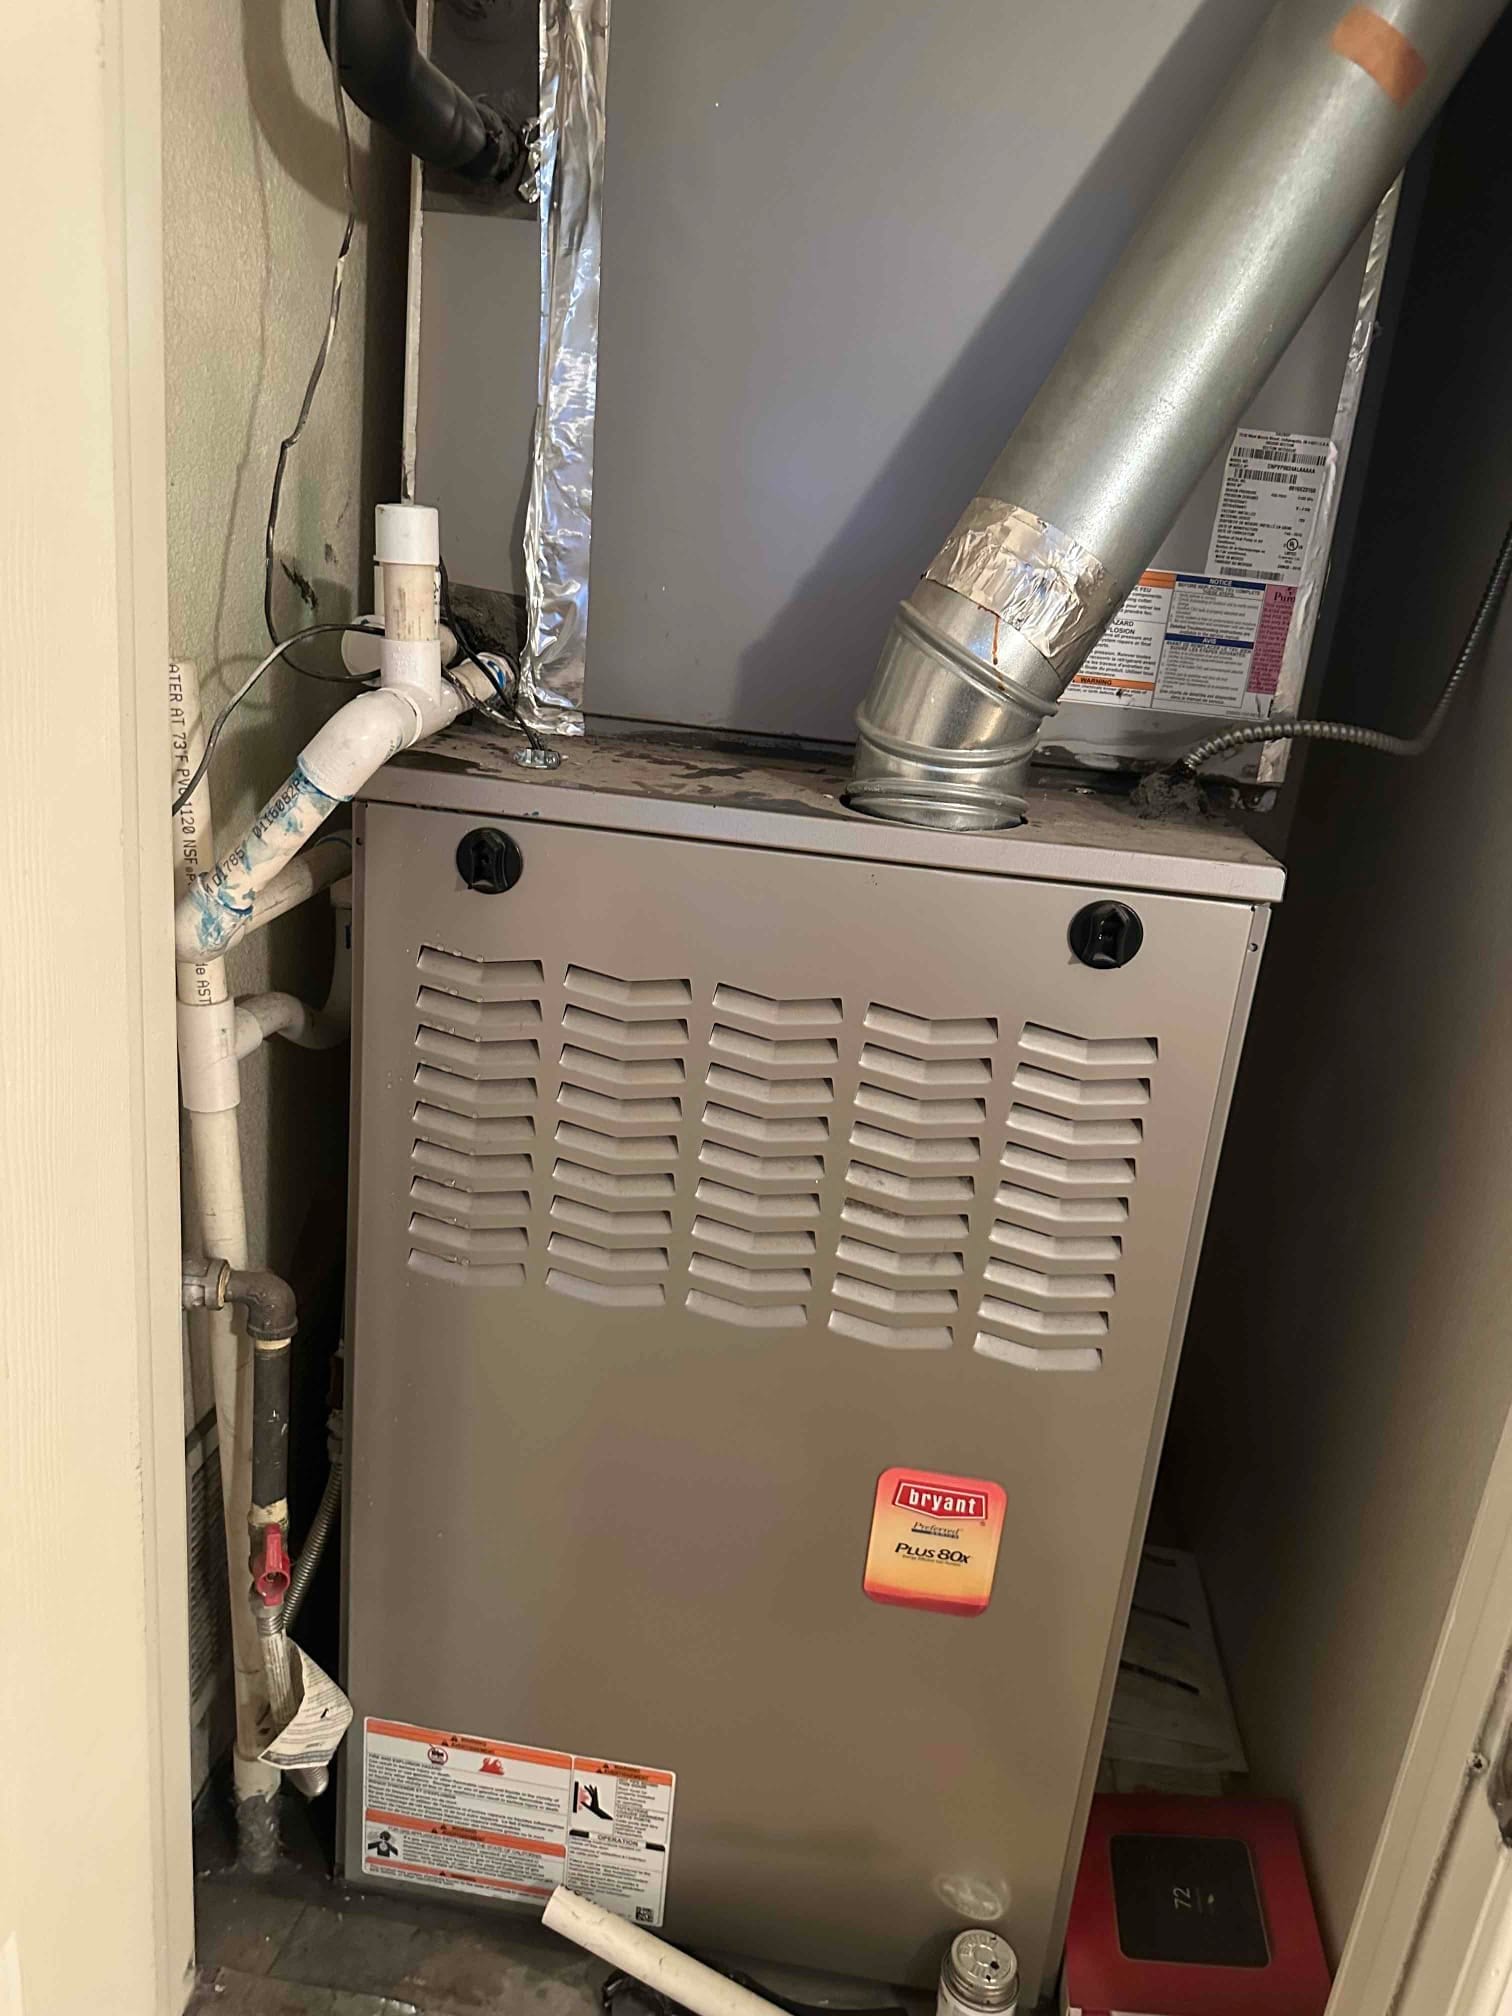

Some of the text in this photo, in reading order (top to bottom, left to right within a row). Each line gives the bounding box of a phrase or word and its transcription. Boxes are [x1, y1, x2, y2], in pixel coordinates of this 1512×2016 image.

[1208, 578, 1232, 587] NOTICE
[1202, 637, 1217, 645] AVIS
[168, 663, 183, 703] ATER
[1080, 677, 1112, 686] WARNING
[170, 707, 185, 726] AT
[183, 839, 198, 865] NSF
[909, 1488, 976, 1515] bryant
[913, 1521, 961, 1537] Preferred
[597, 1833, 639, 1847] OPERATION
[1173, 1887, 1192, 1909] 72
